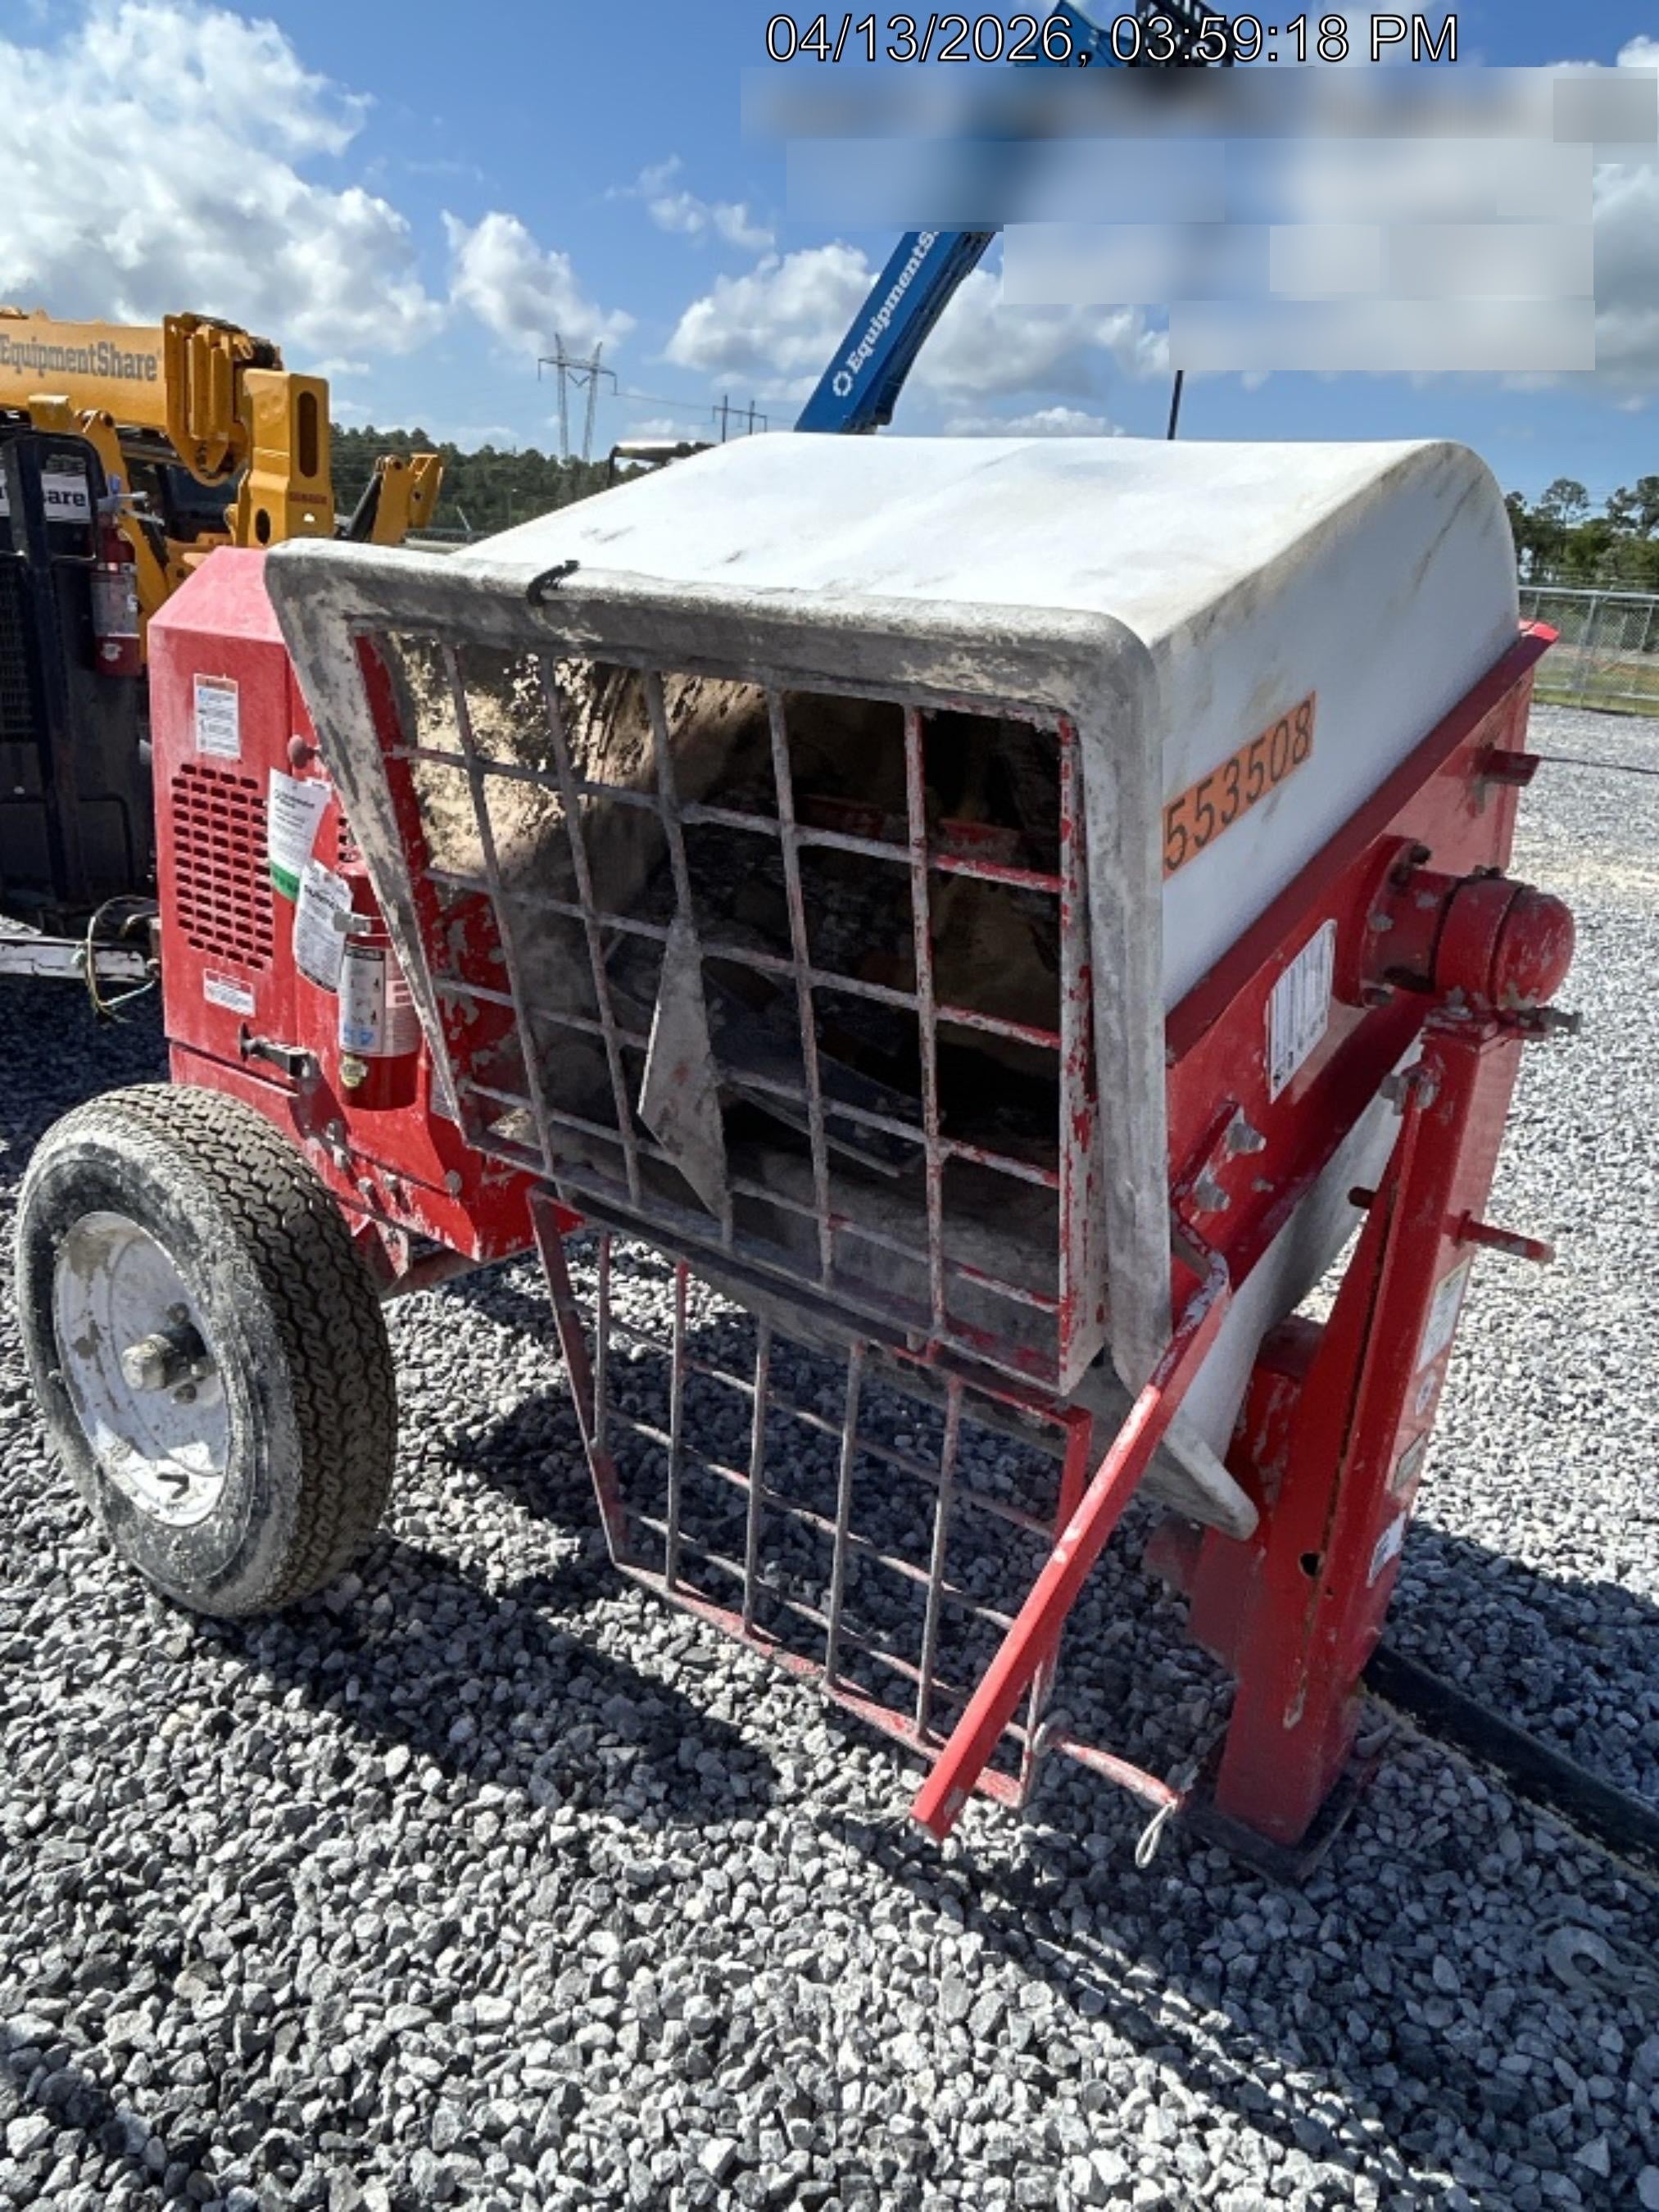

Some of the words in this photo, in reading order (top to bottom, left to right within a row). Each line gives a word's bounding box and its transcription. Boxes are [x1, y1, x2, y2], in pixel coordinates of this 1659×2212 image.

[847, 232, 938, 372] EquipmentS
[0, 334, 157, 381] EquipmentShare
[44, 491, 86, 506] are
[1165, 700, 1311, 870] 553508
